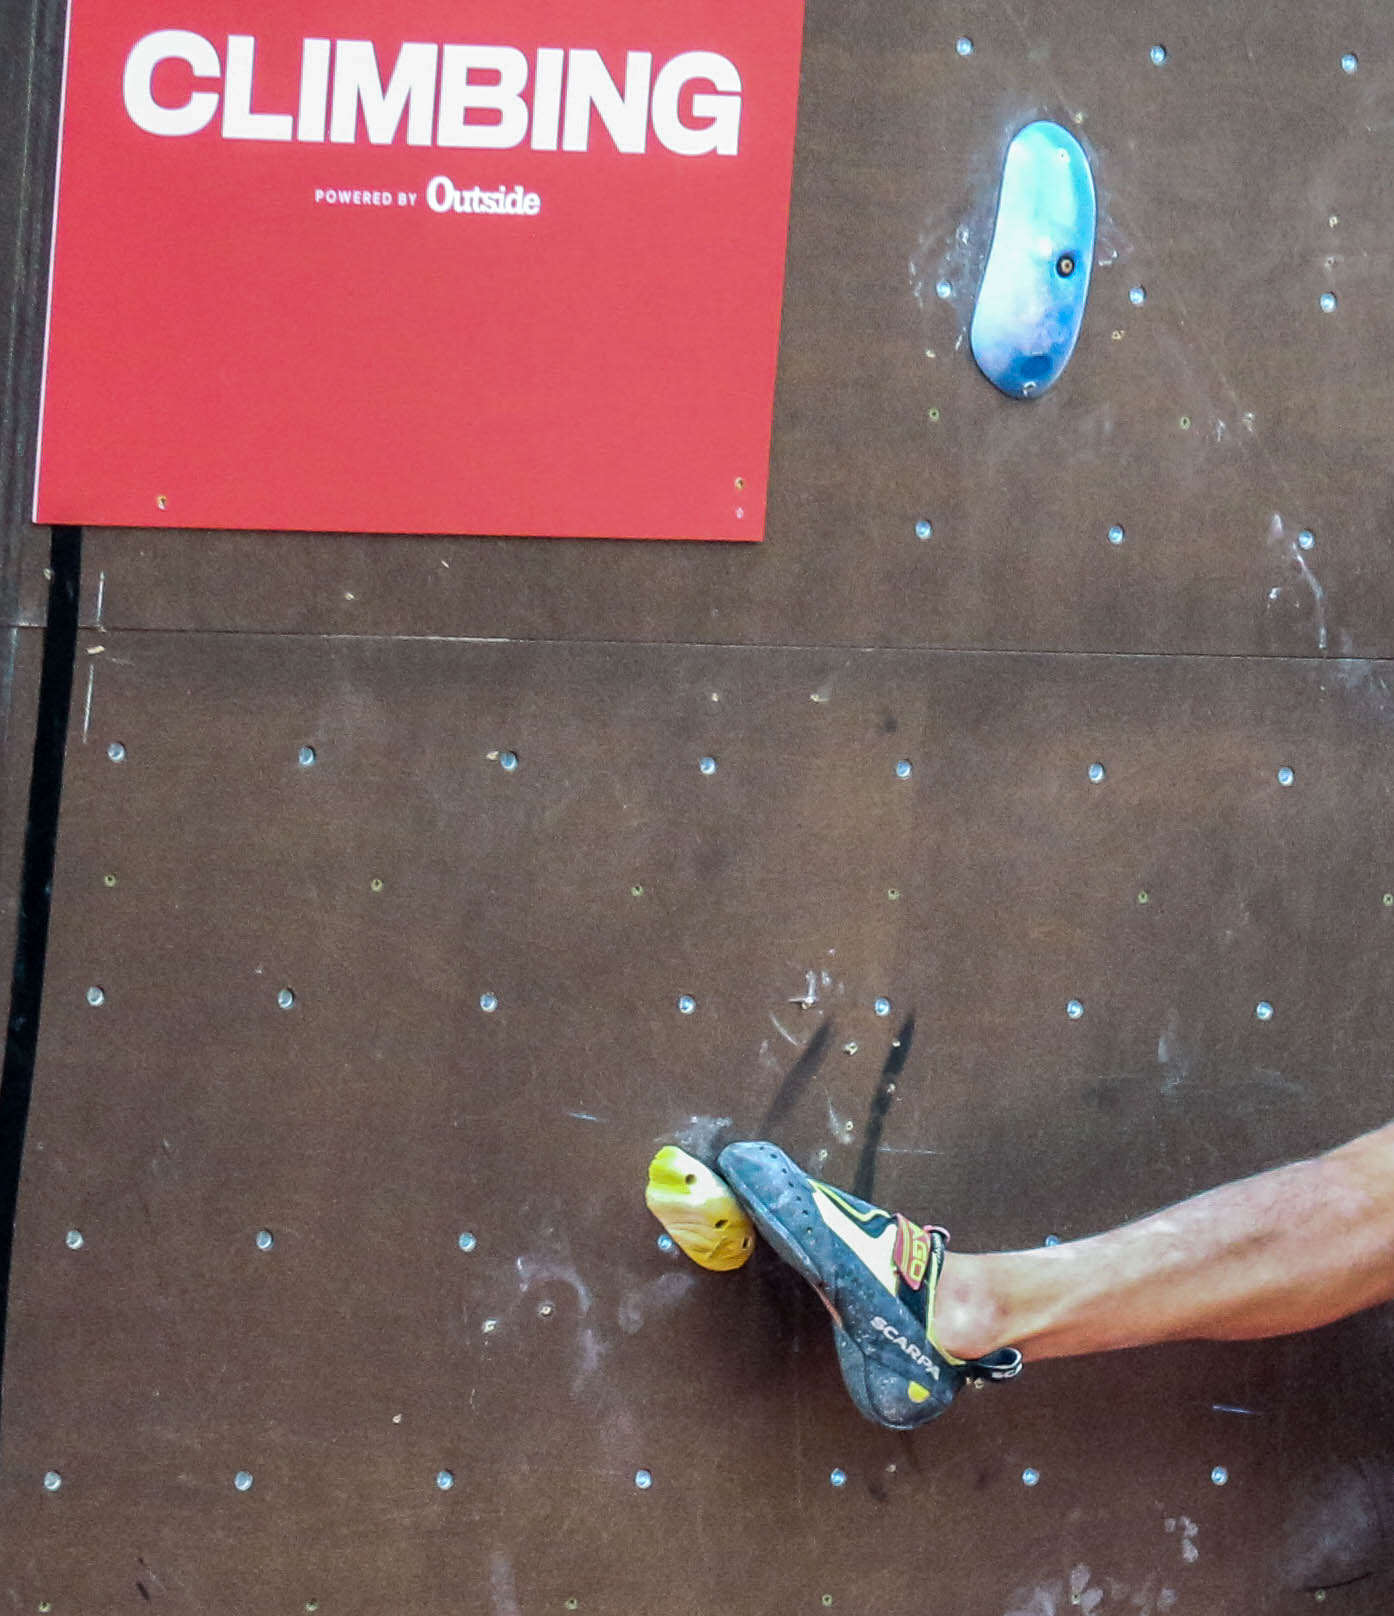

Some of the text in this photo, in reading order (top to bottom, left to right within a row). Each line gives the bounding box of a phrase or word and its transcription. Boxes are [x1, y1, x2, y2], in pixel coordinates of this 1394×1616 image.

[122, 29, 742, 156] CLIMBING
[314, 175, 542, 216] POWERED BY Outside
[870, 1315, 941, 1381] SCARPA
